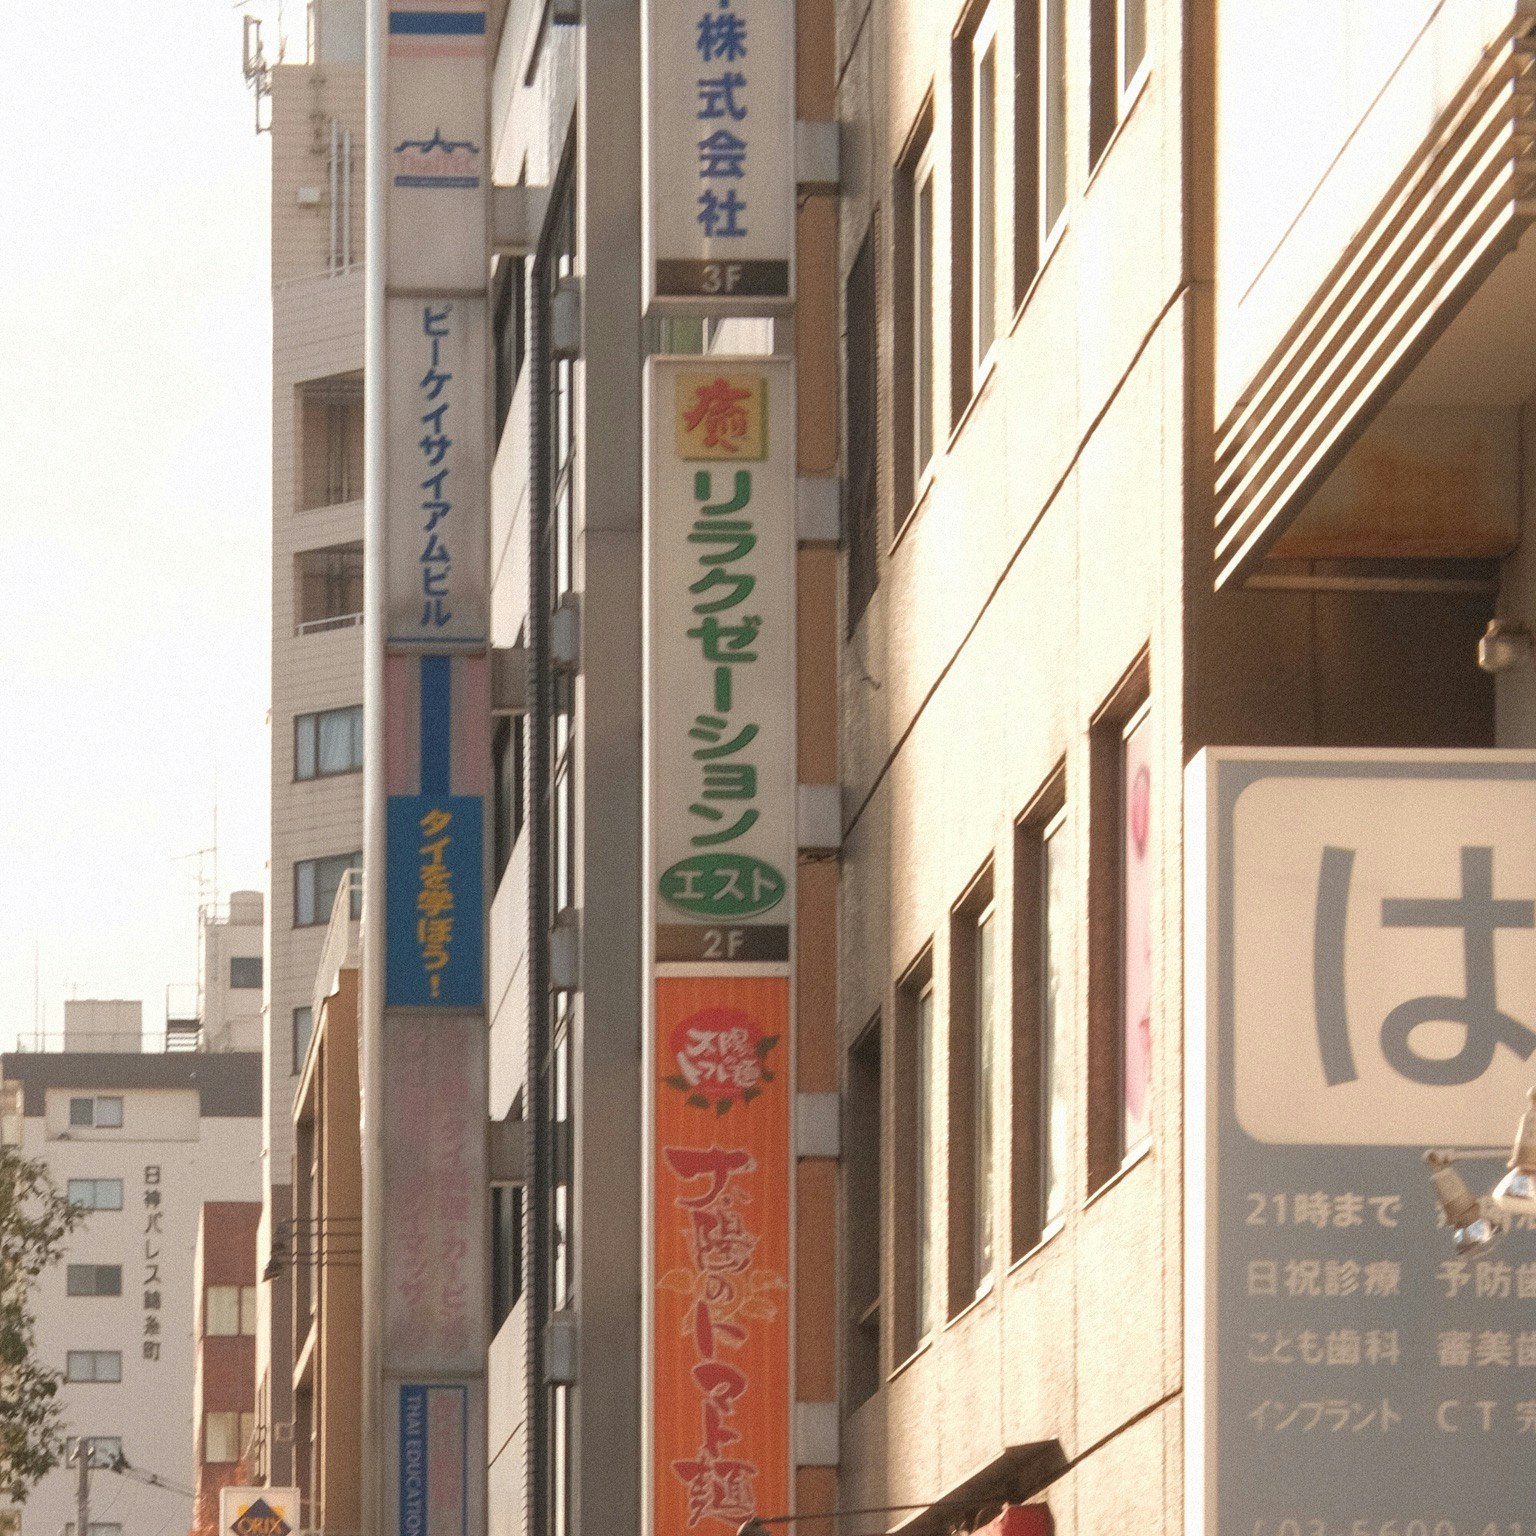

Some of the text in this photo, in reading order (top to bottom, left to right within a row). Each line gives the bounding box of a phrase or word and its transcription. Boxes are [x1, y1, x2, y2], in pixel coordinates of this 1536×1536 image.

[697, 0, 749, 238] 株式会社
[701, 263, 743, 293] 3F
[686, 469, 762, 846] リラクゼーション
[672, 866, 778, 902] エスト
[702, 928, 745, 959] 2F
[1246, 1191, 1403, 1230] 21時まで
[1247, 1259, 1402, 1298] 日祝診療
[1247, 1329, 1400, 1367] こども歯科
[1248, 1401, 1402, 1434] インプラント
